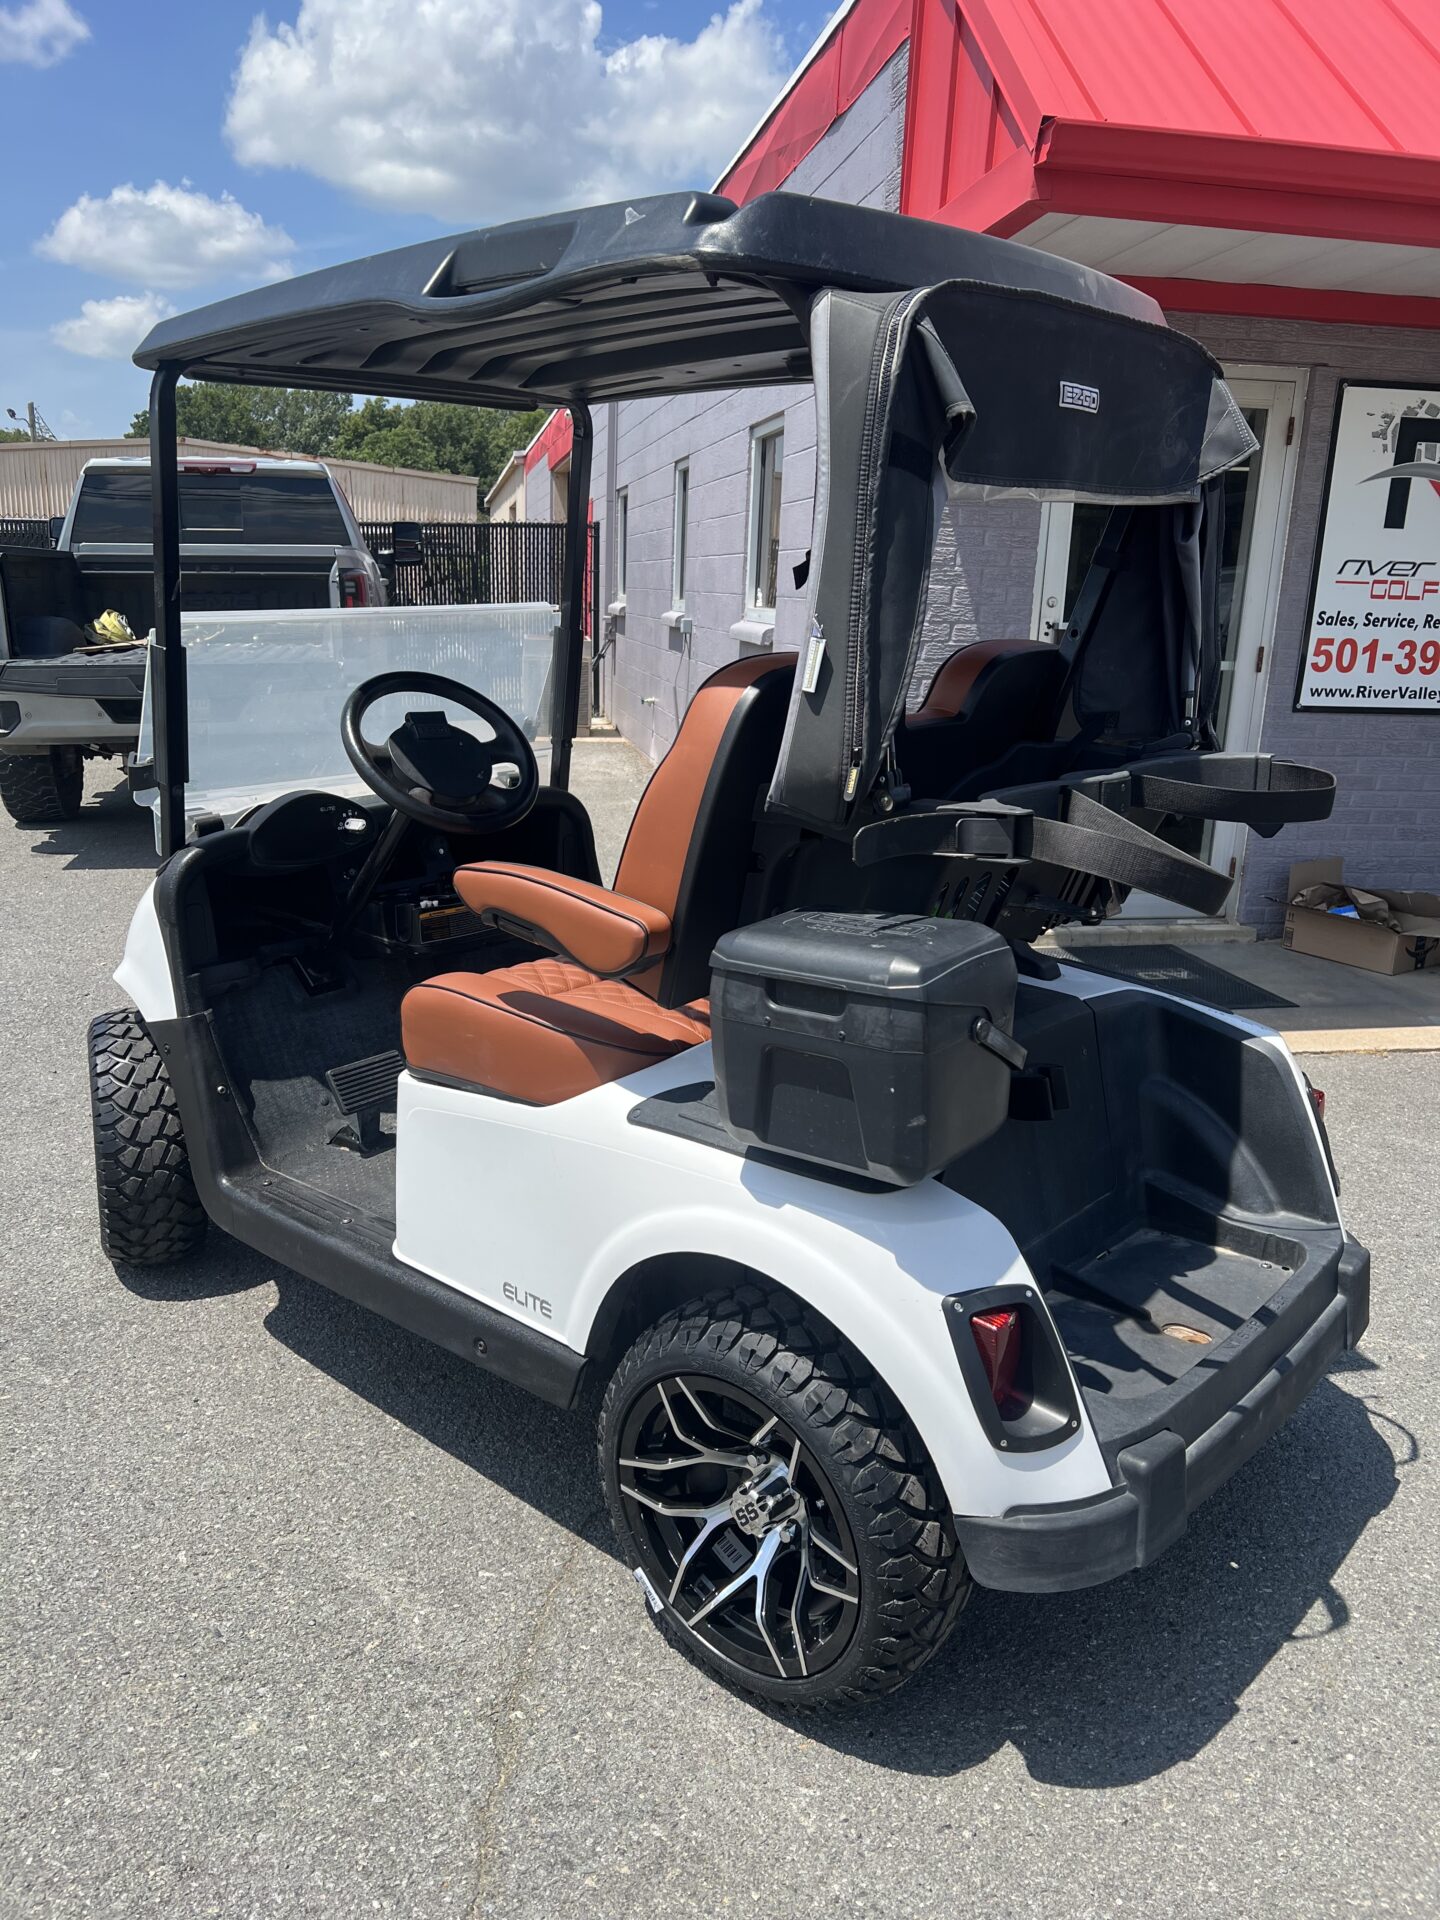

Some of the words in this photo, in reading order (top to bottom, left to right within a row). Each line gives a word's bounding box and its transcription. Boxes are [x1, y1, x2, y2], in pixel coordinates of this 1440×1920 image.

[1370, 579, 1440, 600] GOLF
[1316, 610, 1358, 629] Sales,
[1362, 612, 1419, 631] Service,
[1310, 637, 1440, 675] 501-39
[503, 1281, 552, 1320] ELITE
[735, 1501, 760, 1527] SS
